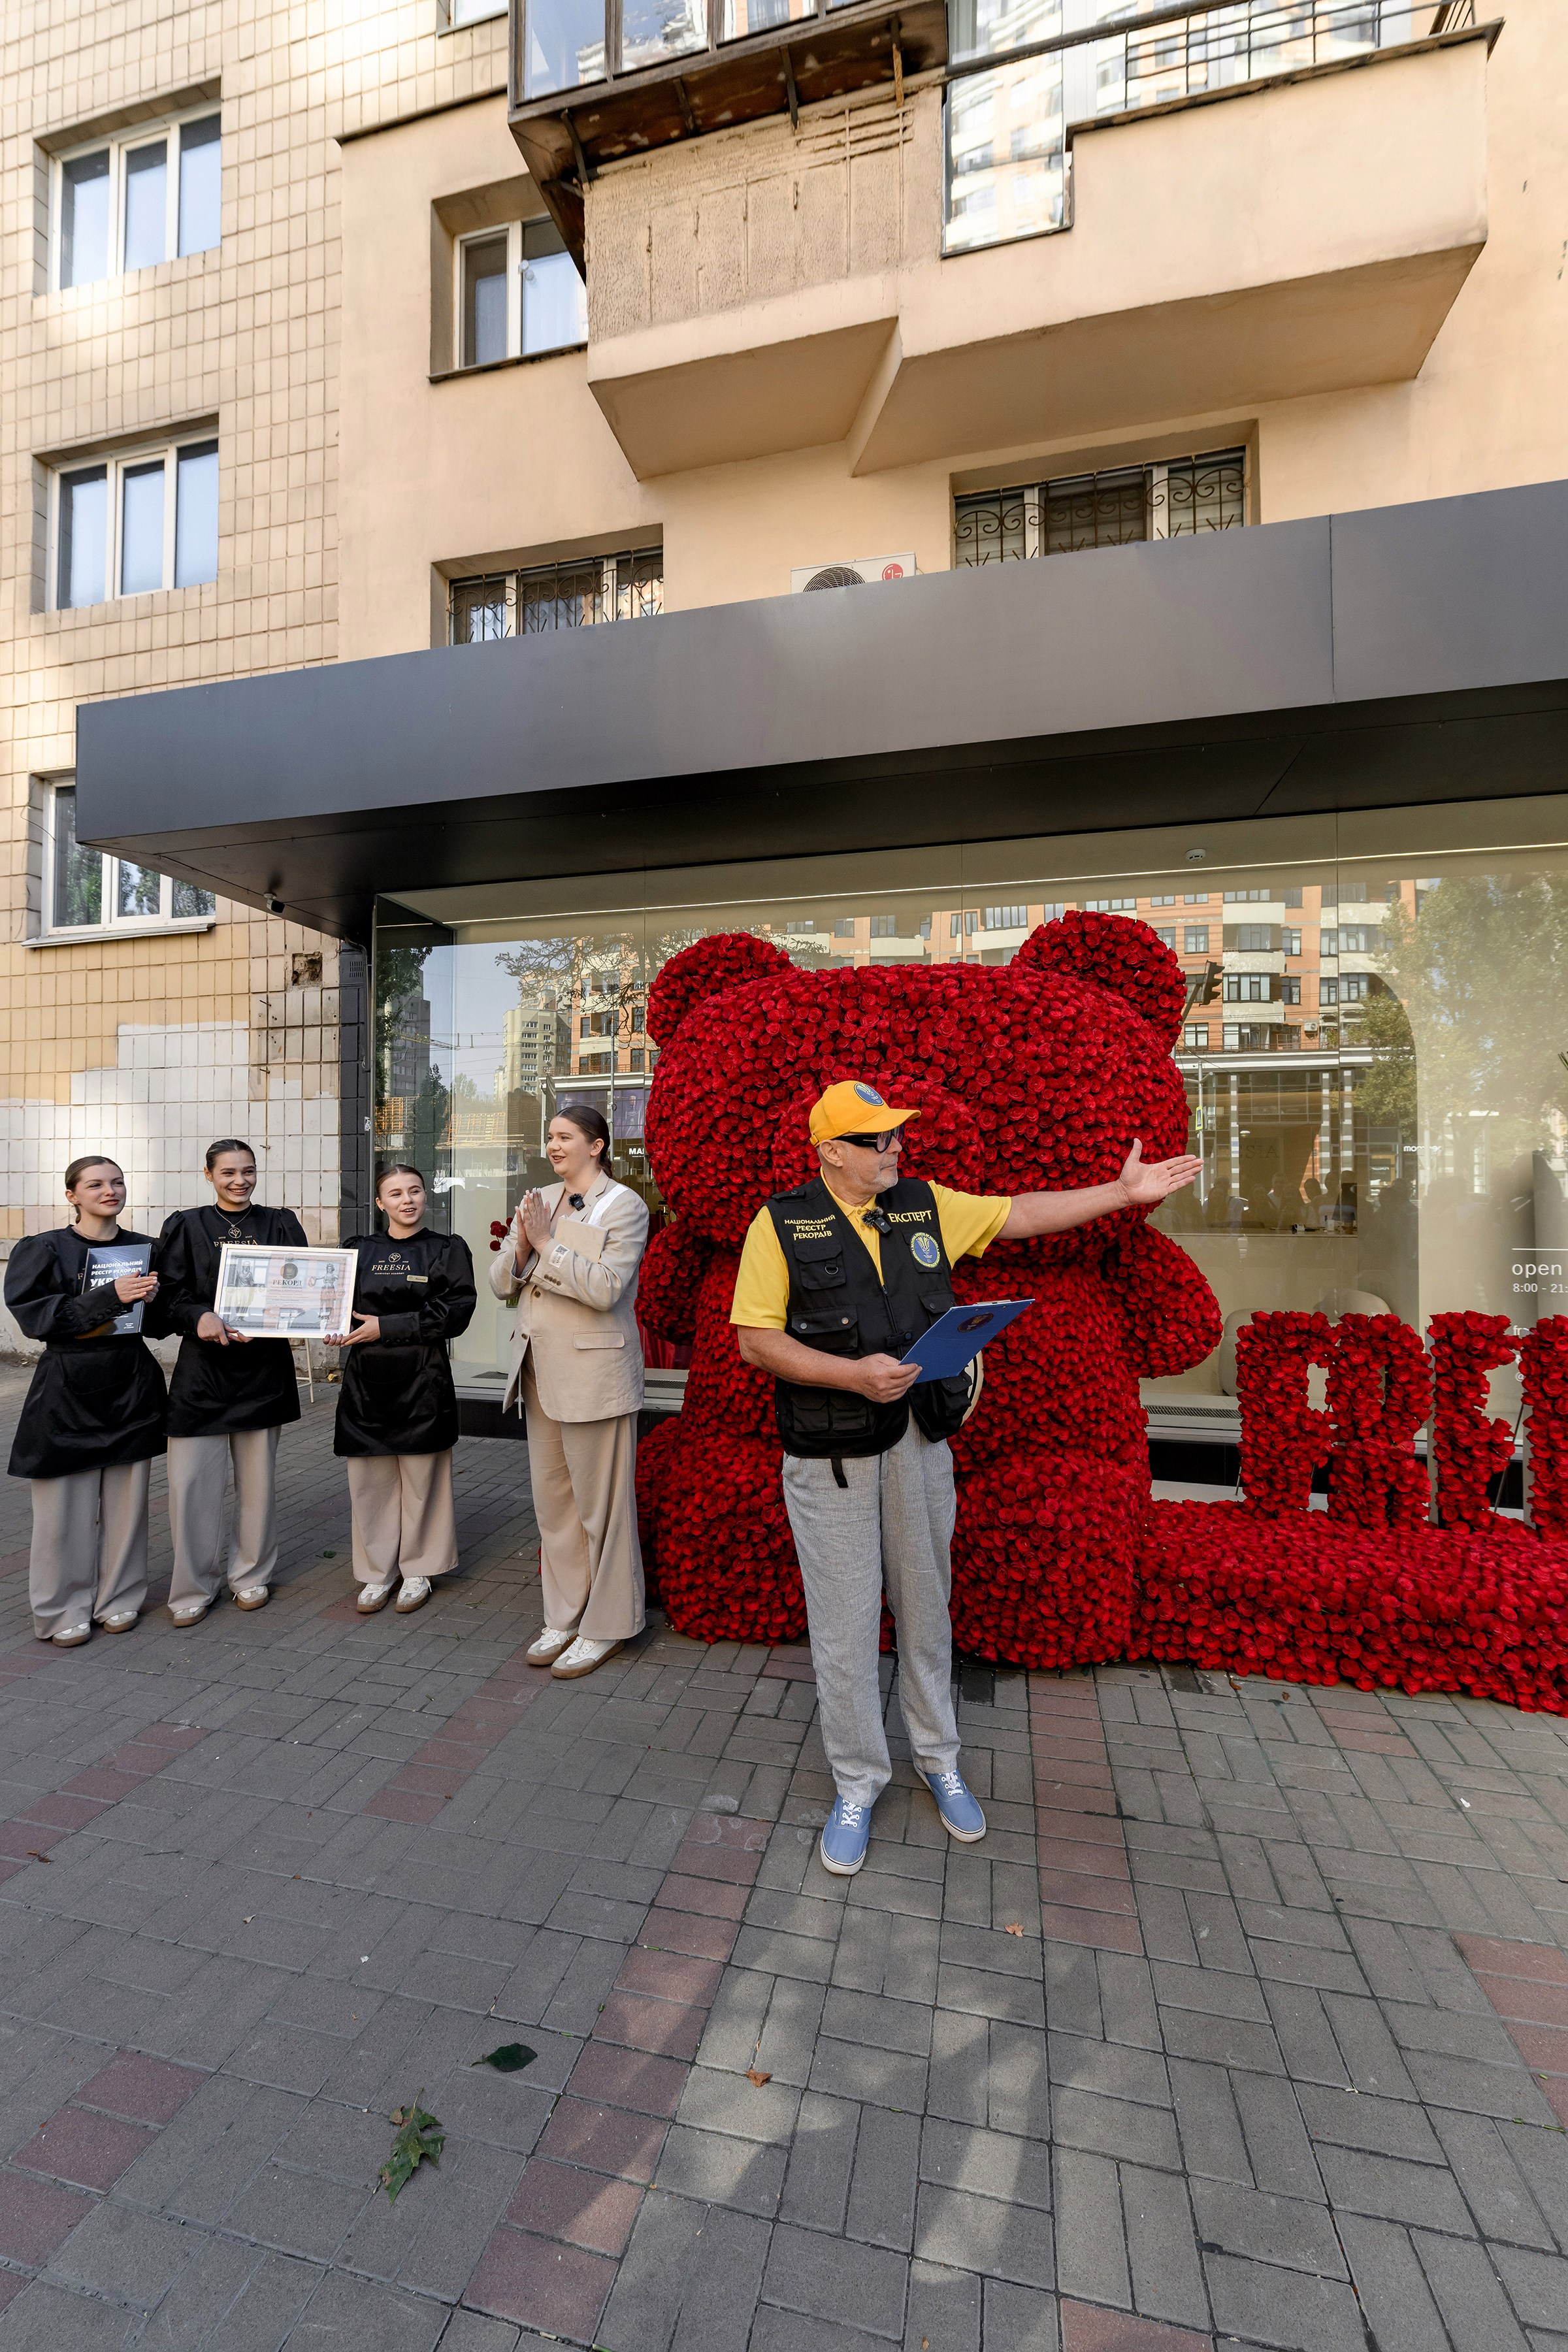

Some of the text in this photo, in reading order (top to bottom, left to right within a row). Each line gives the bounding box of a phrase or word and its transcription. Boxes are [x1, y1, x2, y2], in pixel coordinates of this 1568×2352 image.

[784, 1214, 836, 1224] НАЦІОНАЛЬНИЙ
[887, 1210, 932, 1223] ЕКСПЕРТ
[792, 1230, 832, 1241] РЕКОРДІВ
[92, 1259, 143, 1269] НАЦІОНАЛЬНИЙ
[1511, 1264, 1562, 1279] open
[1512, 1283, 1538, 1292] 8:00
